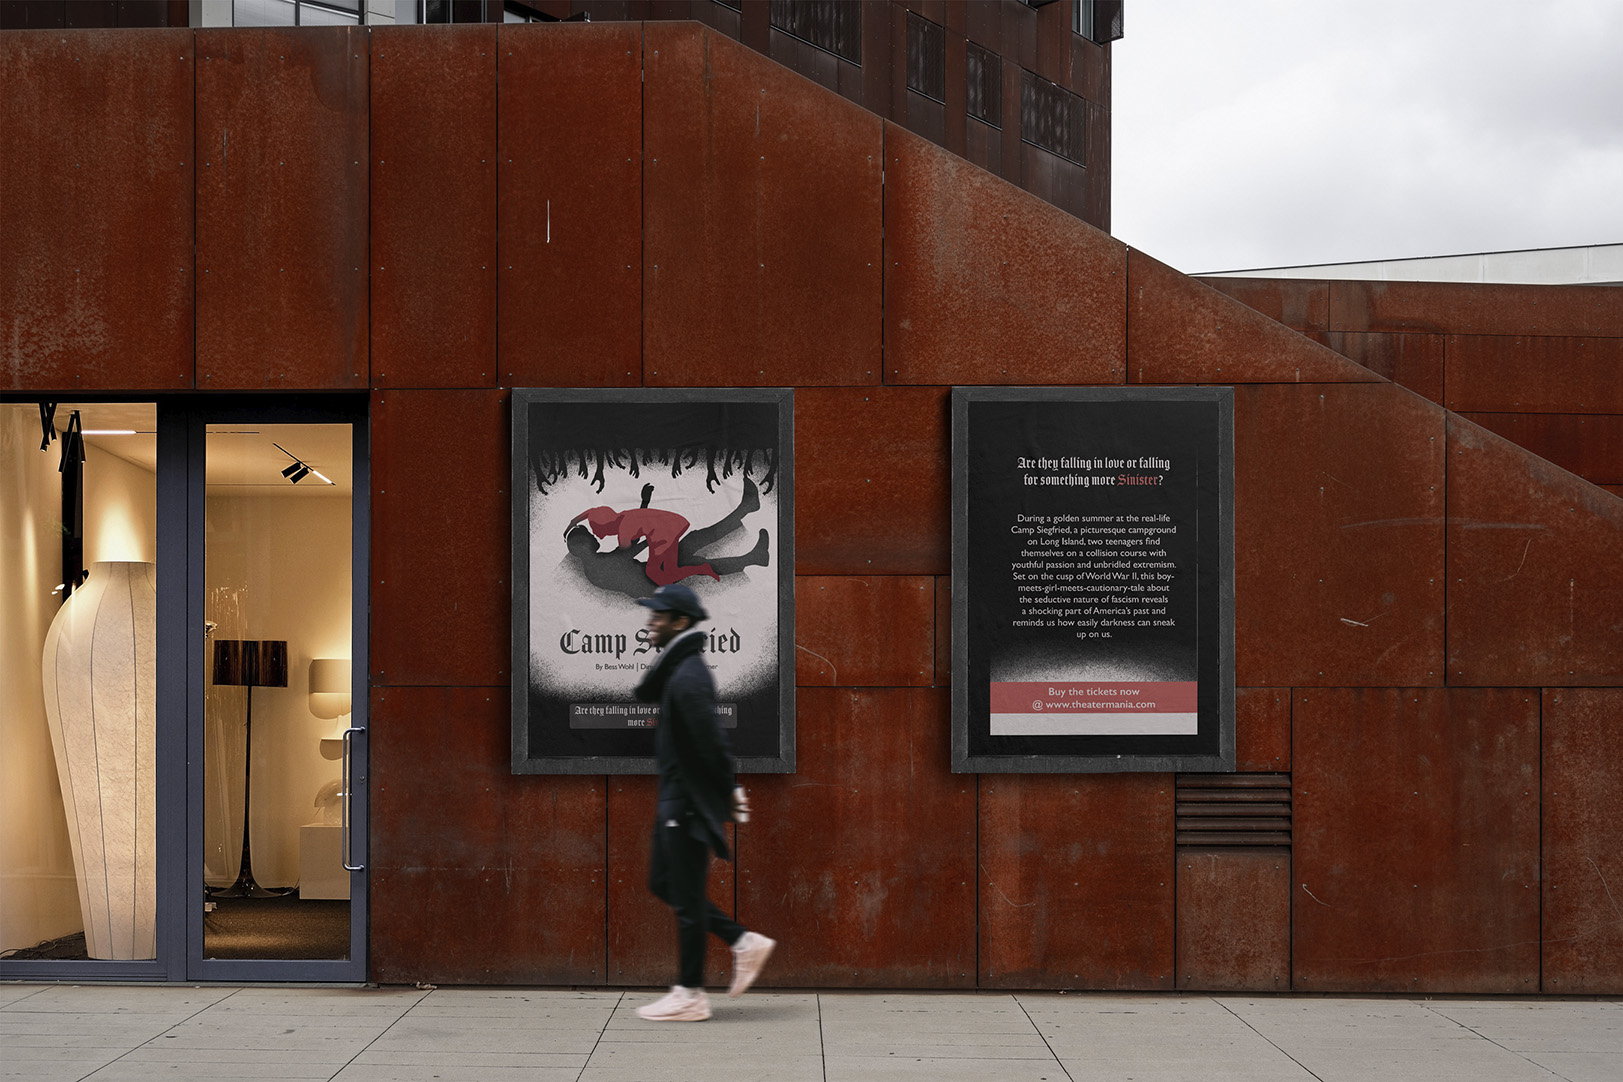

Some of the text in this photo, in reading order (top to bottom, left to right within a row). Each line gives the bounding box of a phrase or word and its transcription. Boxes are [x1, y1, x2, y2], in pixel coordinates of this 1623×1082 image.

[1017, 456, 1170, 471] Are they falling in love or falling
[1024, 473, 1164, 488] for something more Sinister?
[1017, 513, 1045, 525] During
[1053, 513, 1080, 525] golden
[1126, 513, 1139, 522] the
[1141, 513, 1171, 522] real-life
[1011, 525, 1035, 536] Camp
[1036, 525, 1072, 536] Siegfried,
[1080, 525, 1126, 536] picturesque
[1128, 525, 1177, 536] campground
[1040, 537, 1060, 548] Long
[1062, 537, 1086, 546] Island,
[1105, 538, 1143, 548] teenagers
[1145, 536, 1161, 545] find
[1021, 548, 1064, 557] themselves
[1085, 548, 1118, 557] collision
[1149, 548, 1167, 557] with
[1011, 560, 1177, 572] youthful passion and unbridled extremism.
[1013, 571, 1026, 580] Set
[1040, 571, 1054, 580] the
[1056, 574, 1074, 583] cusp
[1076, 570, 1087, 580] of
[1085, 570, 1111, 580] World
[1111, 571, 1130, 580] War
[1140, 571, 1155, 580] this
[1157, 571, 1175, 583] boy-
[1018, 583, 1170, 595] meets-girl-meets-cautionary-tale about
[1019, 595, 1032, 604] the
[1034, 595, 1071, 604] seductive
[1101, 594, 1110, 603] of
[1111, 594, 1140, 603] fascism
[1141, 594, 1169, 603] reveals
[1028, 606, 1063, 618] shocking
[1065, 608, 1082, 618] part
[1083, 606, 1093, 615] of
[1133, 608, 1150, 618] past
[1151, 606, 1166, 615] and
[1012, 618, 1044, 627] reminds
[1057, 618, 1075, 627] how
[1077, 618, 1099, 630] easily
[1100, 618, 1135, 627] darkness
[1153, 618, 1175, 626] sneak
[1076, 632, 1087, 641] up
[560, 629, 627, 660] Camp
[595, 663, 603, 671] By
[1048, 687, 1066, 698] Buy
[1068, 687, 1084, 696] the
[1086, 687, 1117, 696] tickets
[1045, 699, 1156, 709] www.theatermania.com
[574, 706, 588, 715] Are
[589, 705, 604, 717] they
[605, 705, 628, 716] falling
[629, 705, 636, 715] in
[637, 705, 652, 715] love
[627, 719, 645, 727] more
